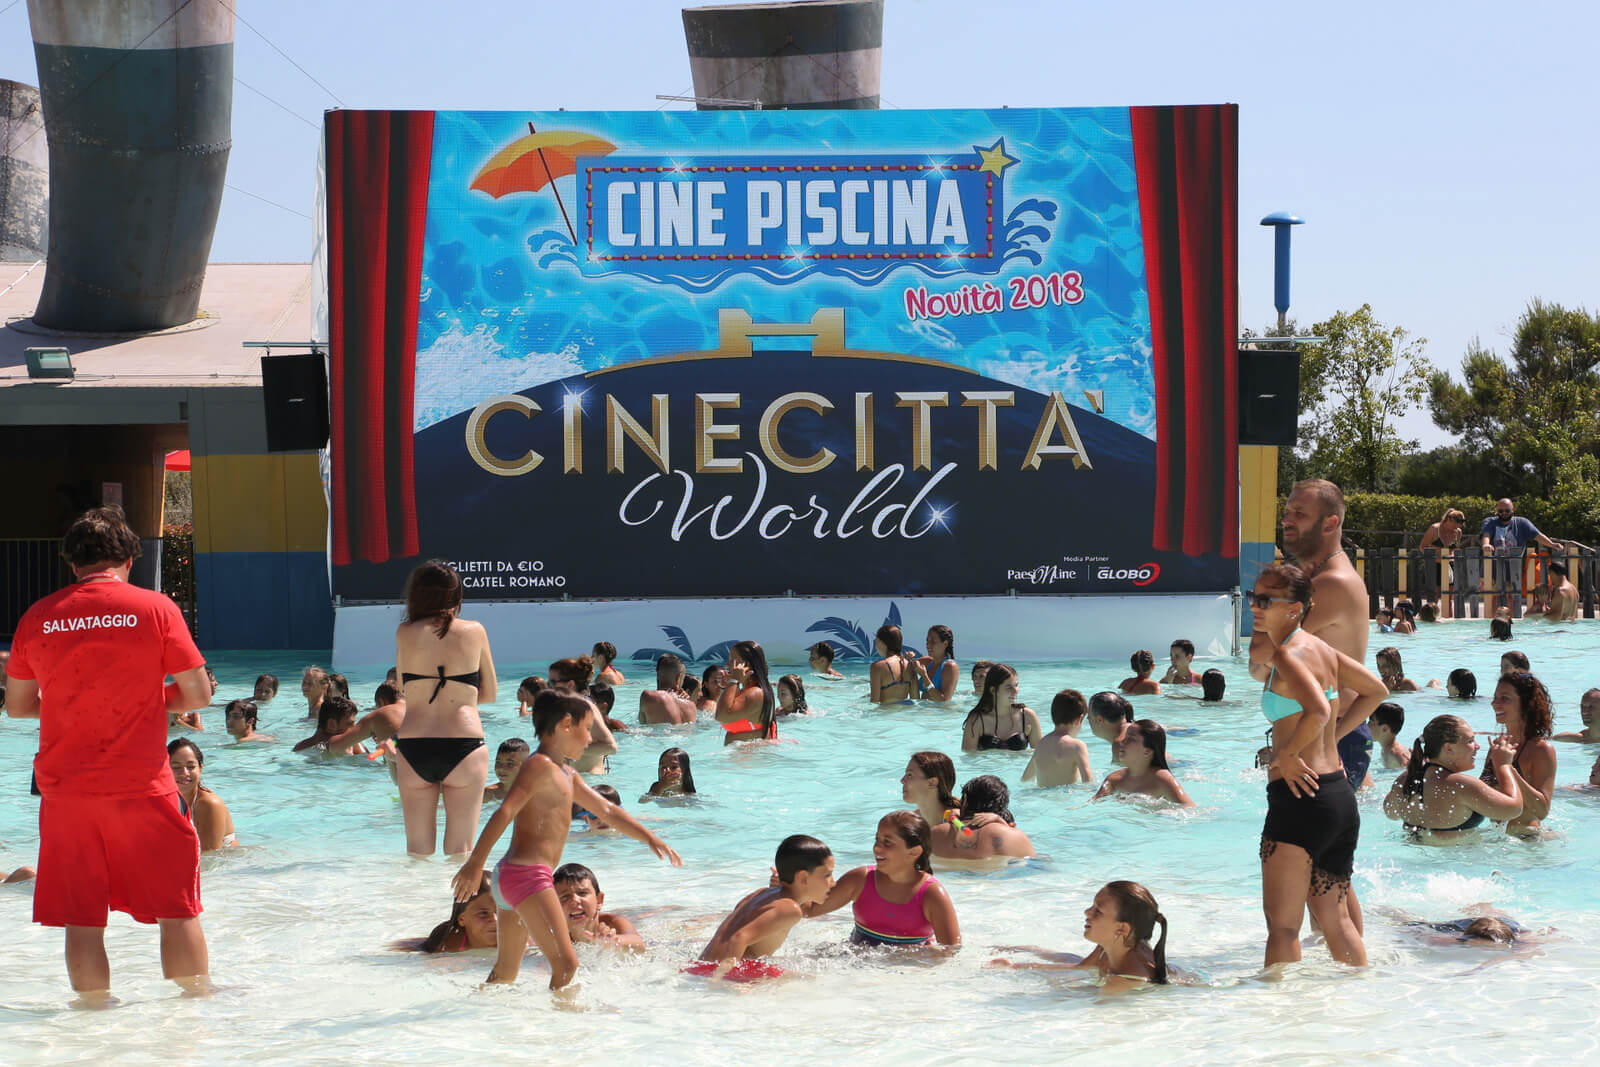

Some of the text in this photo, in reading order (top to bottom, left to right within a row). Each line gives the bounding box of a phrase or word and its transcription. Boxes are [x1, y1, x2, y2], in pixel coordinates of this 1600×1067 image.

[607, 179, 969, 247] CINE PISCINA
[905, 271, 1084, 320] Novità 2018
[619, 451, 958, 542] World
[497, 561, 513, 572] DA
[1097, 569, 1151, 580] GLOBO
[463, 576, 566, 588] CASTEL ROMANO
[43, 614, 138, 634] SALVATAGGIO
